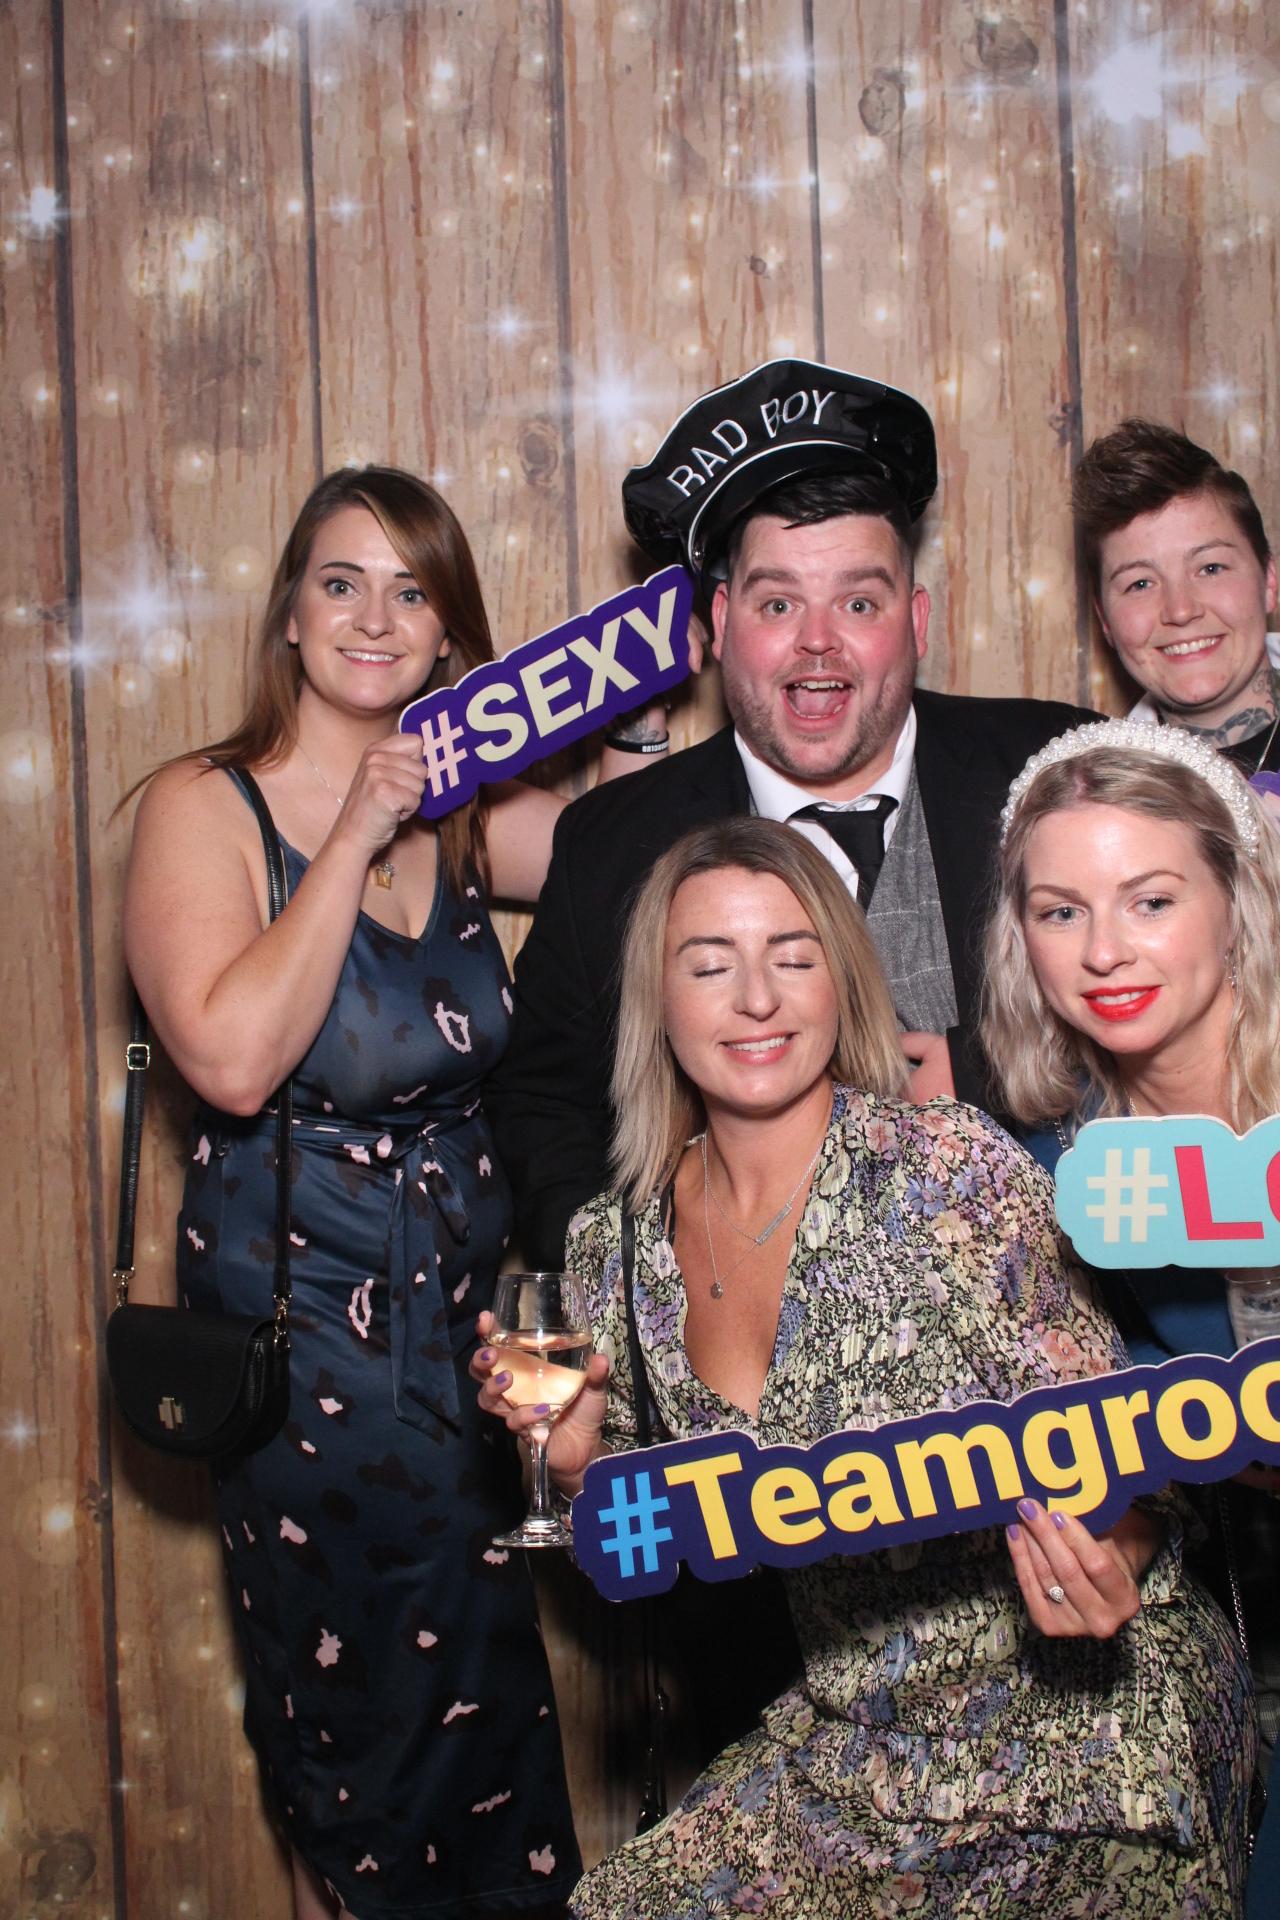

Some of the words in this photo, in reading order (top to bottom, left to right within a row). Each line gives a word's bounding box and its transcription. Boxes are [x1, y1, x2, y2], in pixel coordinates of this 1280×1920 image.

[666, 419, 748, 497] BAD
[760, 389, 836, 438] BOY
[421, 586, 678, 798] #SEXY
[1086, 1145, 1280, 1241] #L
